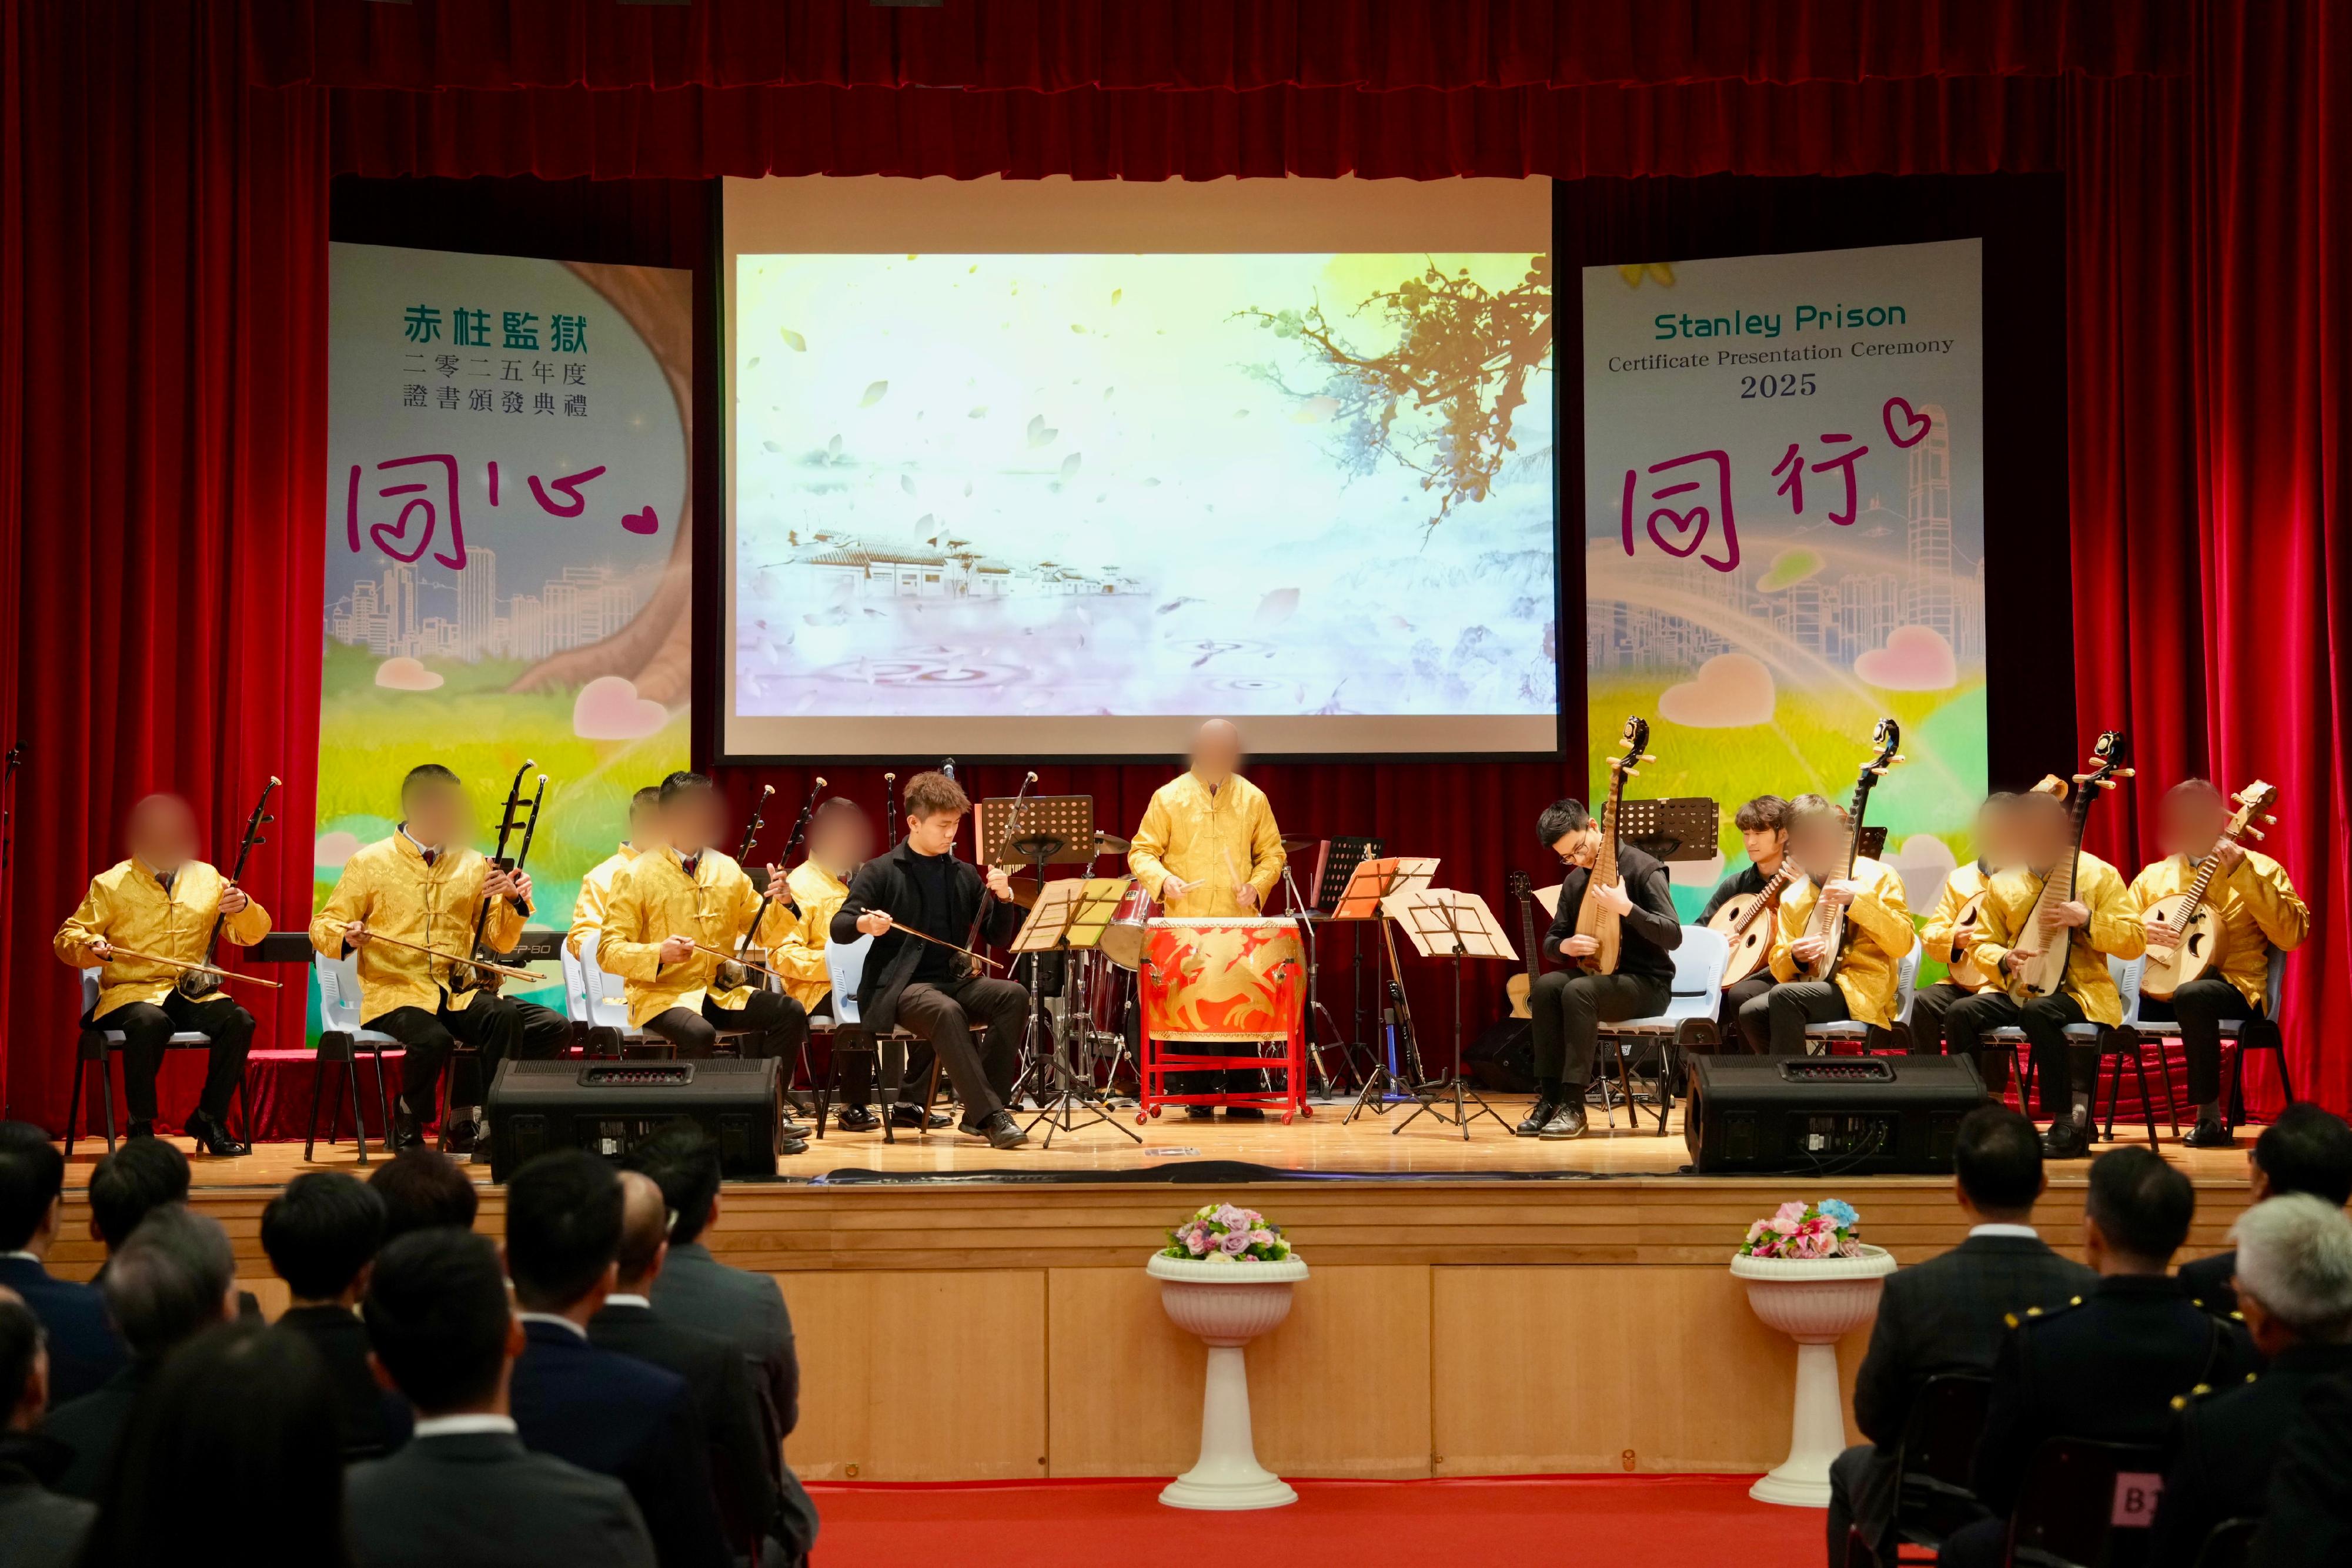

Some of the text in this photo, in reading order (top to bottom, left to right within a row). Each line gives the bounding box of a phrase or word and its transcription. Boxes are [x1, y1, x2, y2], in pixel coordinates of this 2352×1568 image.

[405, 305, 587, 354] 赤柱監獄
[1655, 303, 1906, 340] Stanley Prison
[403, 354, 587, 386] 二零二五年度
[1608, 339, 1954, 372] Certificate Presentation Ceremony
[403, 383, 587, 417] 證書頒發典禮
[1740, 373, 1817, 399] 2025
